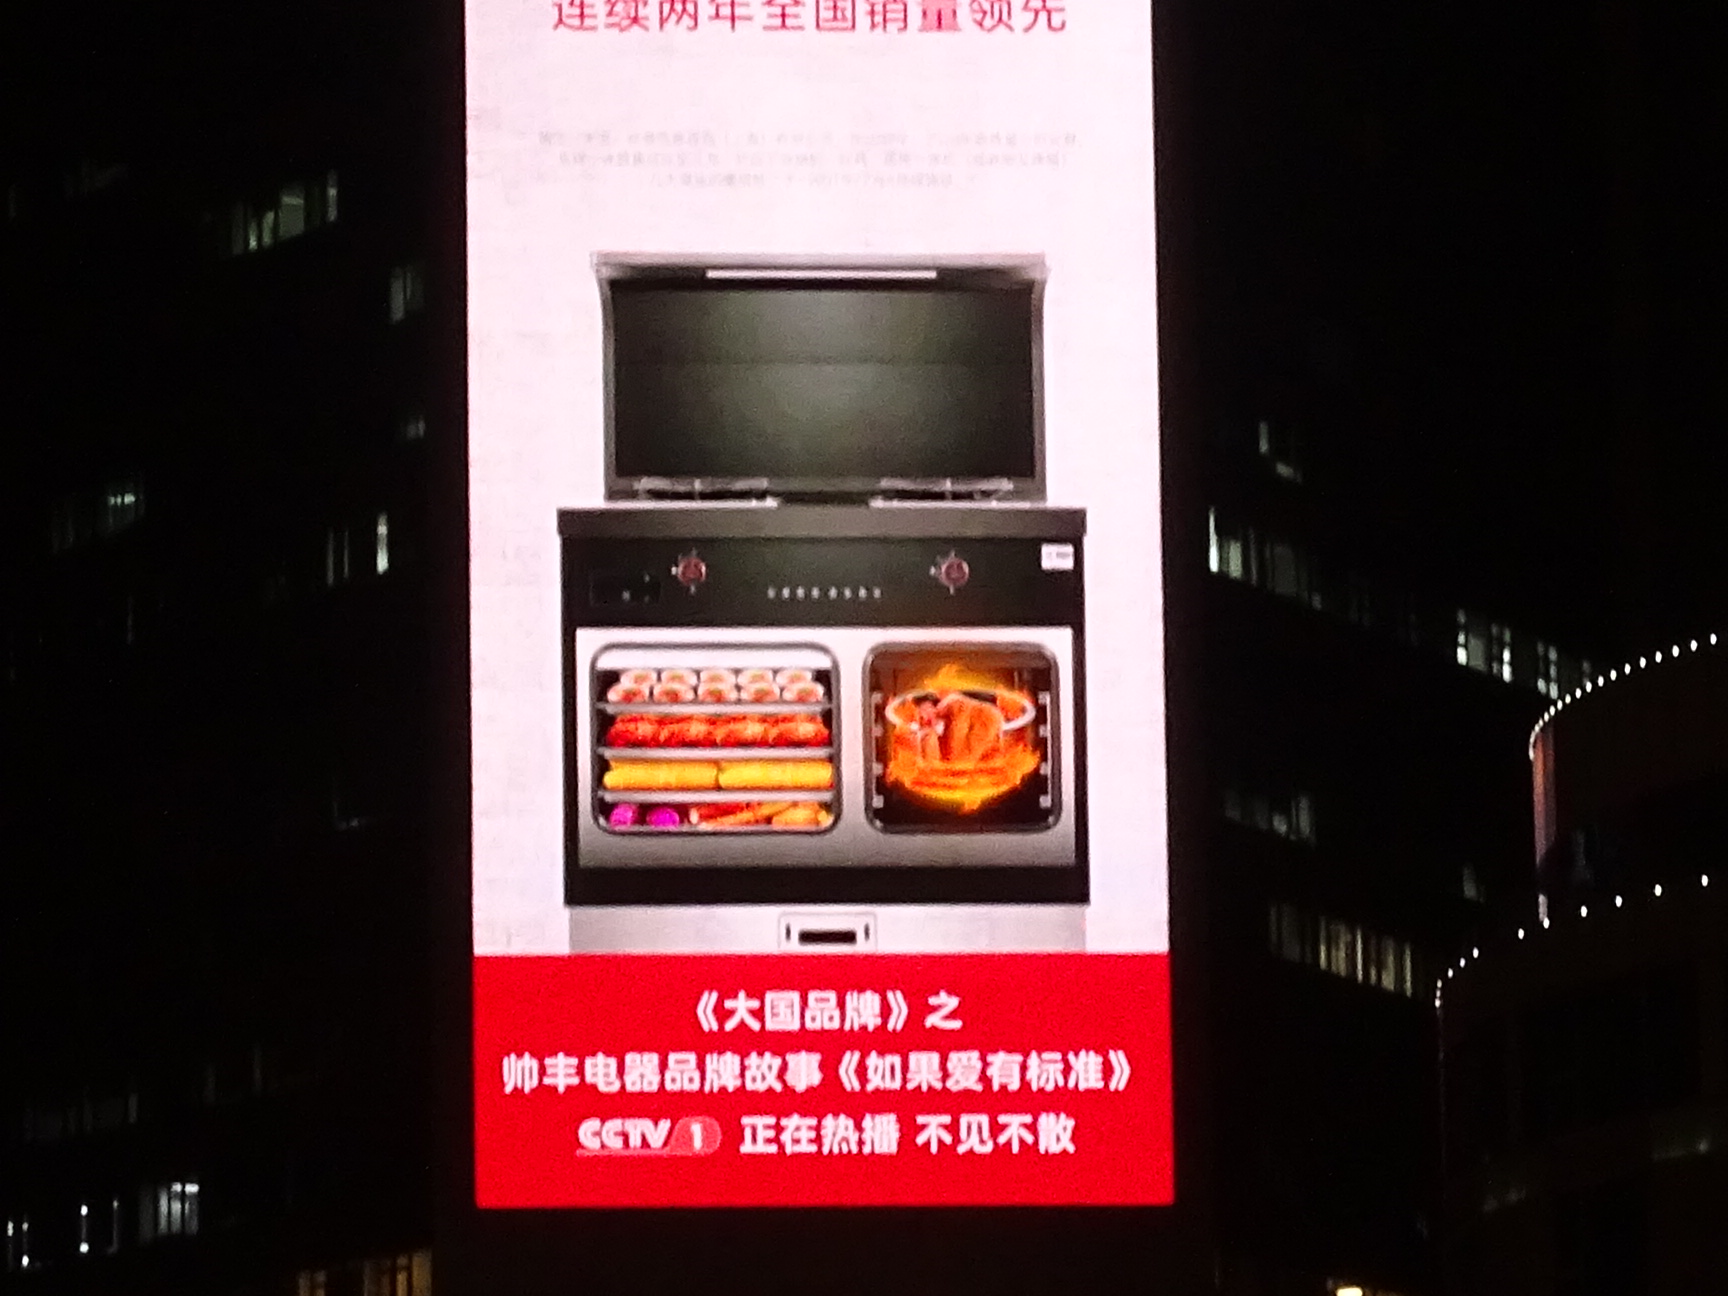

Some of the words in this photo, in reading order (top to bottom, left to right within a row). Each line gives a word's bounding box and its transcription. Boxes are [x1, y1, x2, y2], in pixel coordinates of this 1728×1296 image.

[578, 1117, 672, 1150] CCTV
[739, 1114, 901, 1156] 正在热播
[916, 1113, 1077, 1156] 不见不散
